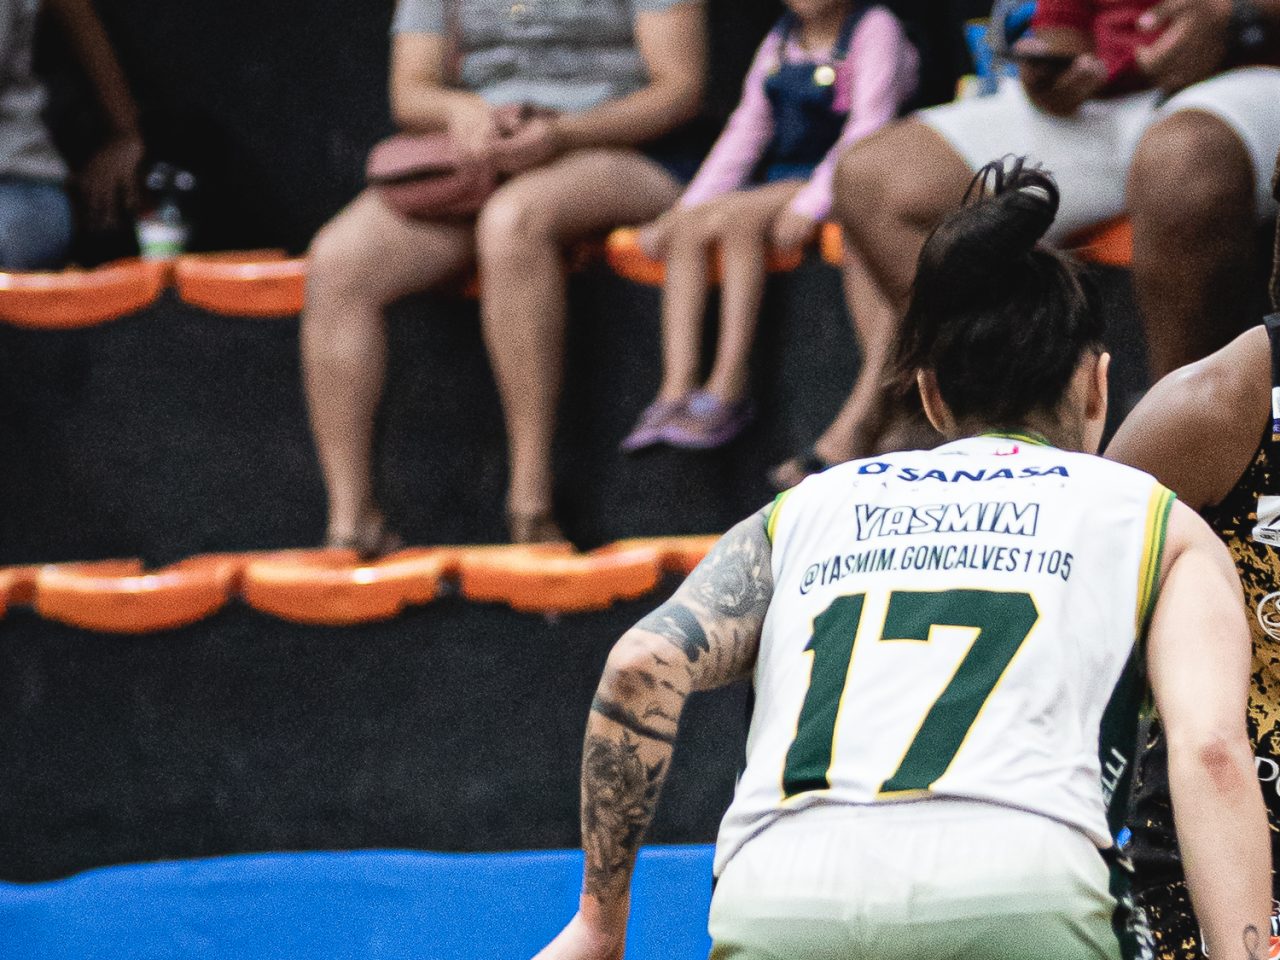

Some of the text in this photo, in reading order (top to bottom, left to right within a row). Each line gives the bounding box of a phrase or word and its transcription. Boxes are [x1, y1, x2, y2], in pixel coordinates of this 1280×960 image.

[897, 465, 1069, 483] SANASA
[855, 501, 1040, 541] YASMIM
[799, 544, 1074, 595] @YASMIM.GONCALVES1105
[782, 589, 1039, 801] 17
